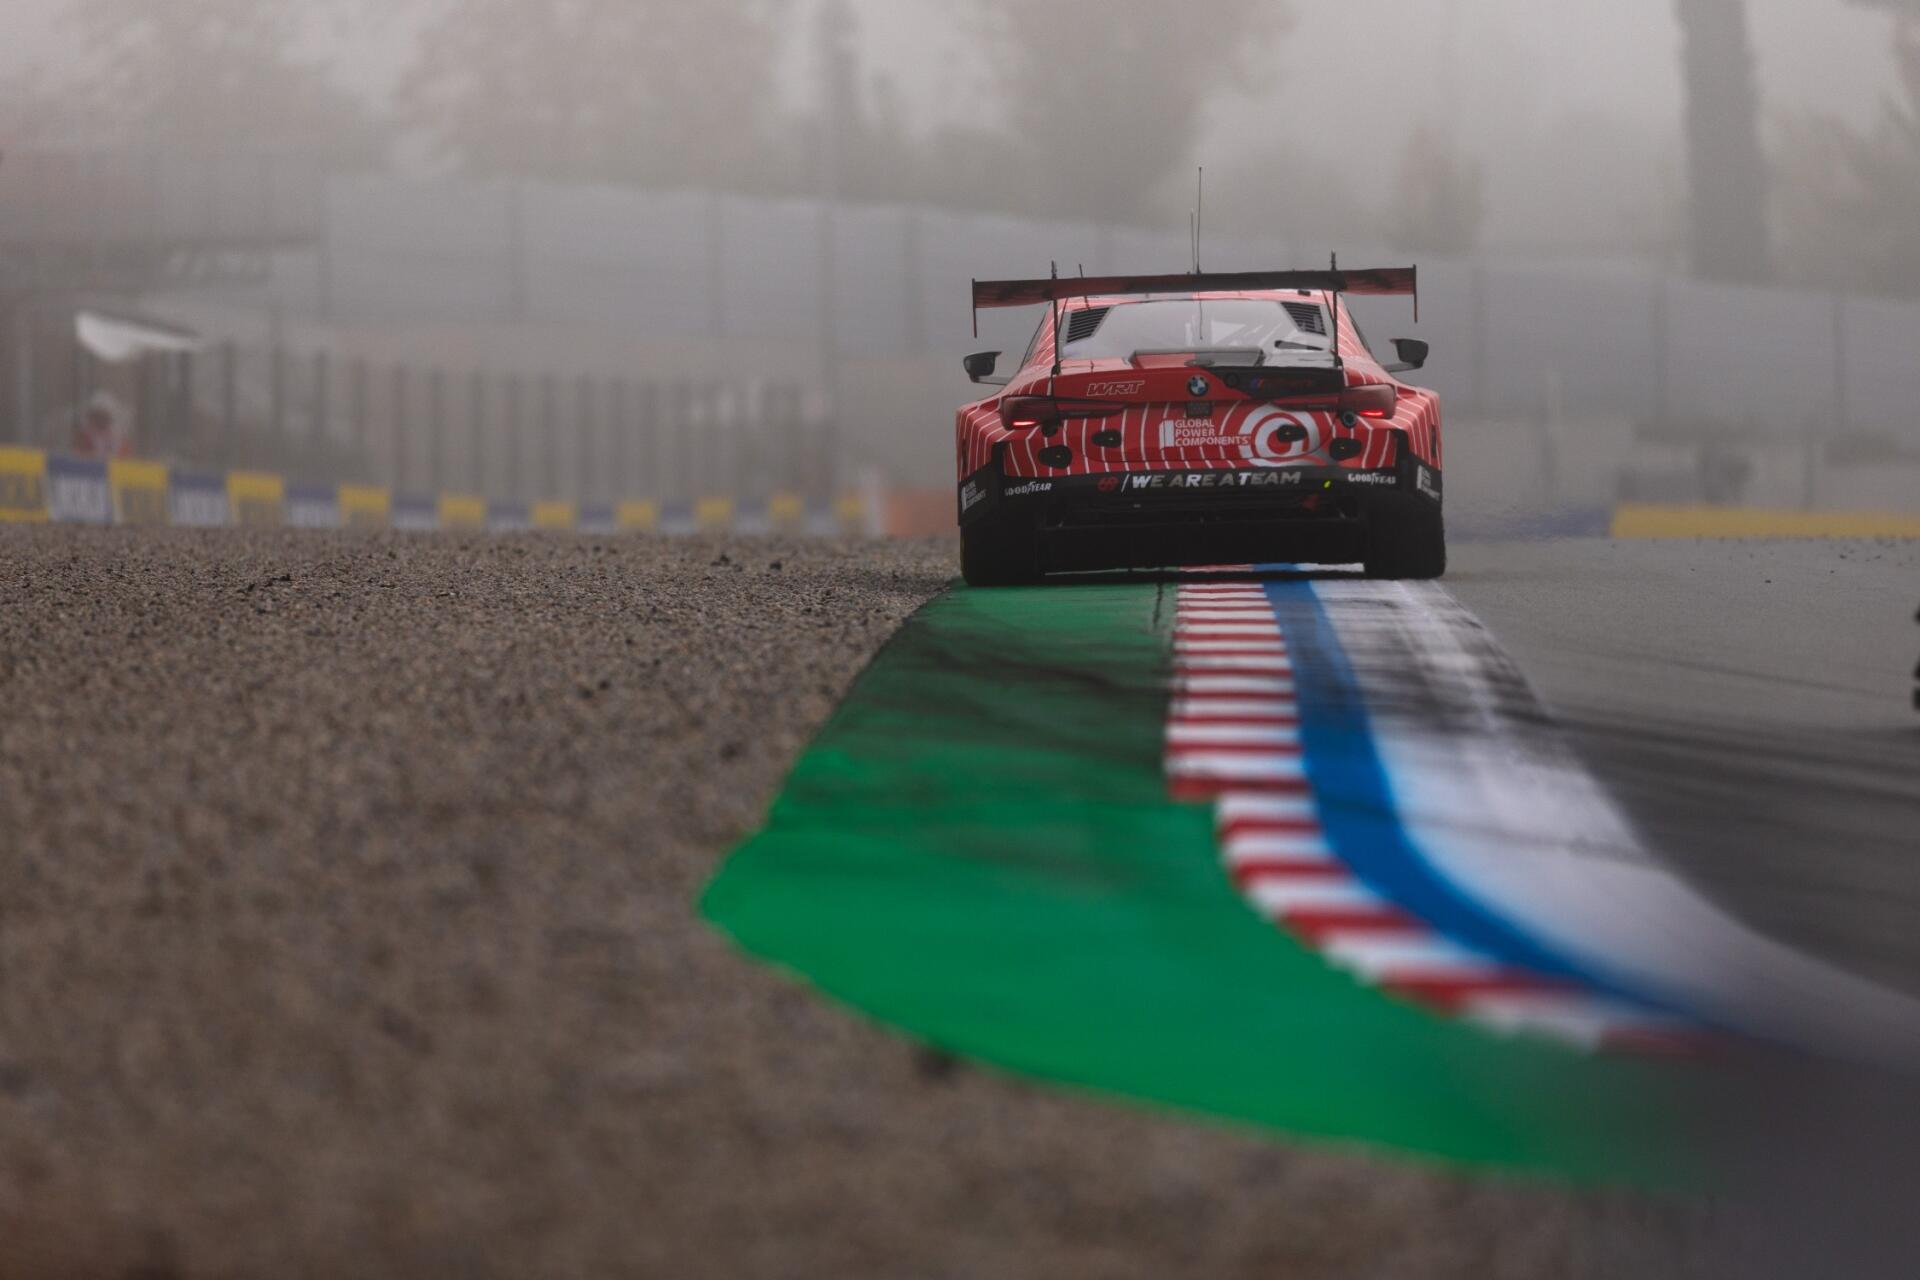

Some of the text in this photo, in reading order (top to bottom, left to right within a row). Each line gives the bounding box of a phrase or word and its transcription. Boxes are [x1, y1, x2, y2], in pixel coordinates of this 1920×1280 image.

[1086, 380, 1145, 397] WRT
[1175, 419, 1215, 428] GLOBAL
[1175, 428, 1216, 437] POWER
[1175, 436, 1249, 447] COMPONENTS
[1132, 475, 1168, 489] WE
[1168, 474, 1217, 487] ARE
[1219, 473, 1235, 486] A
[1239, 471, 1302, 486] TEAM
